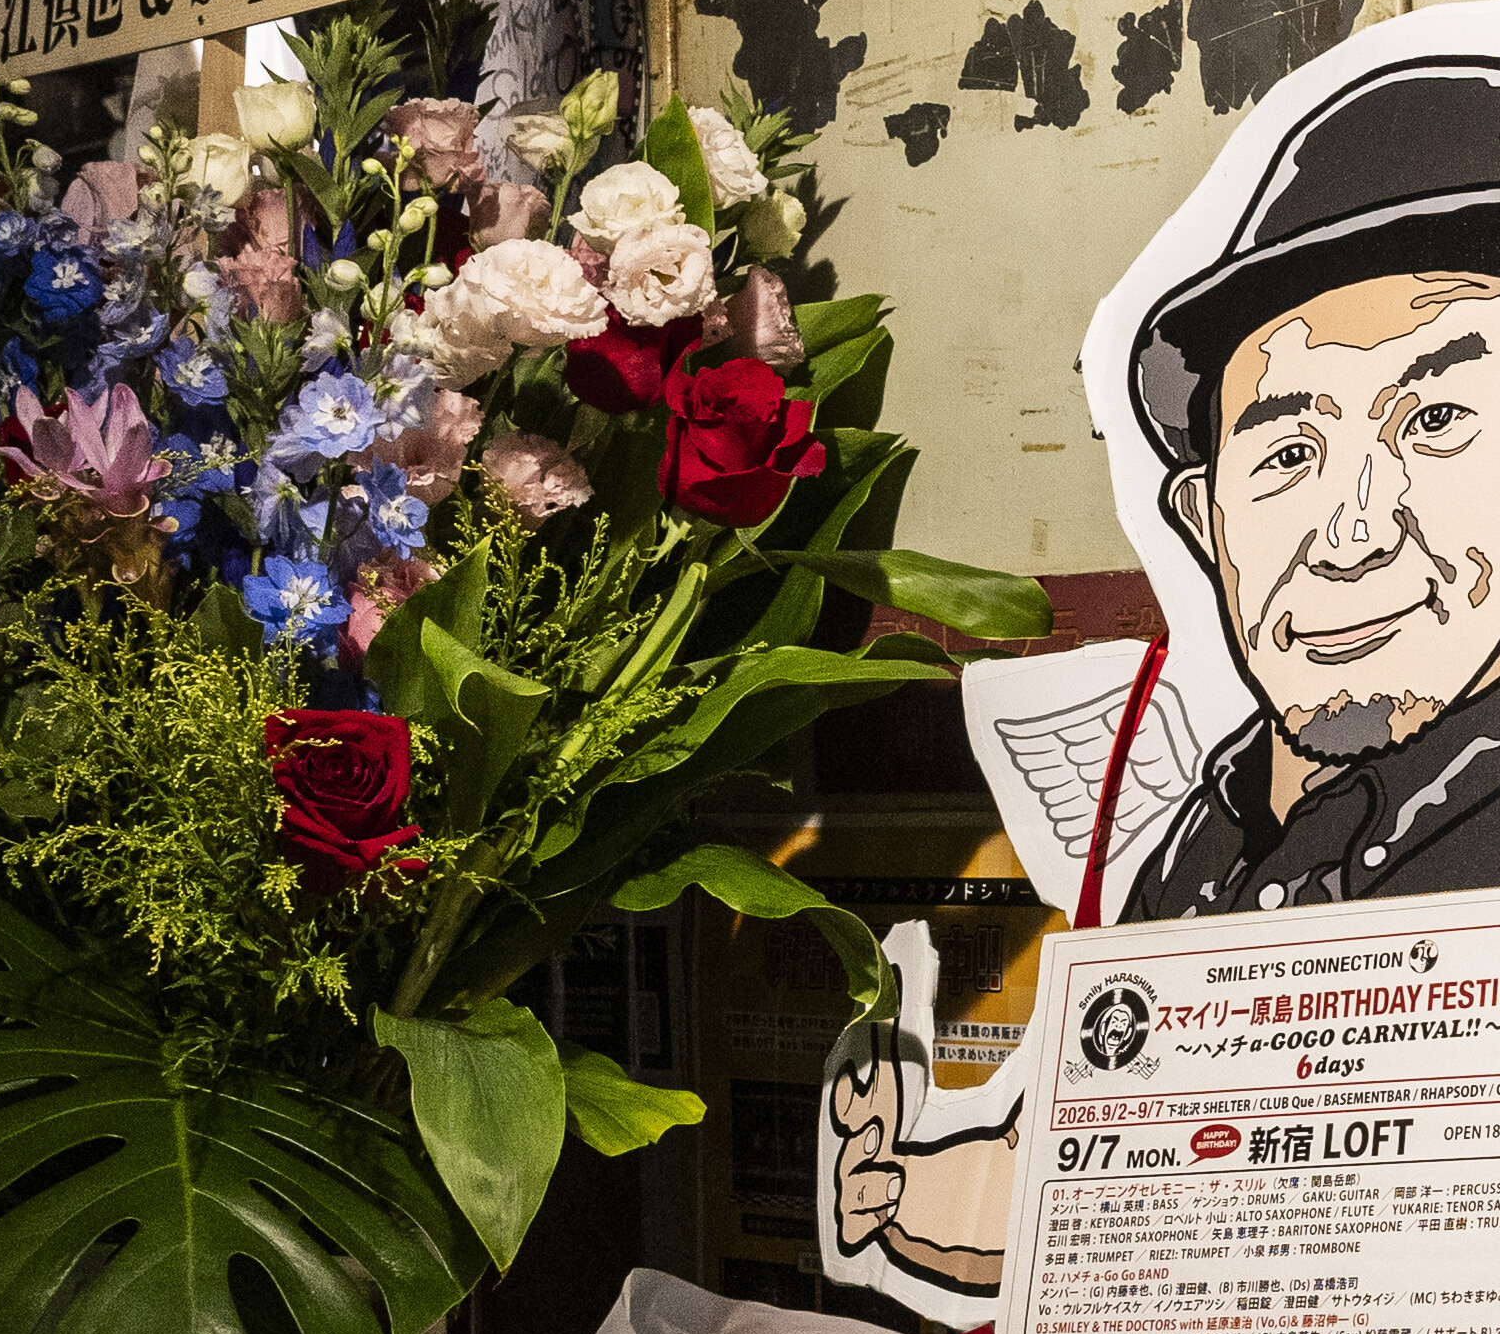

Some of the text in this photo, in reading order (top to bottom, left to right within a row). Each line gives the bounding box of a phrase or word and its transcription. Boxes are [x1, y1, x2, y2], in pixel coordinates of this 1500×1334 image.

[1206, 951, 1404, 984] SMILEY'S CONNECTION
[1104, 972, 1158, 1005] HARASHIMA
[1154, 994, 1293, 1033] スマイリー原島
[1297, 984, 1423, 1022] BIRTHDAY
[1202, 1098, 1251, 1115] SHELTER
[1323, 1089, 1412, 1107] BASEMENTBAR
[1420, 1084, 1487, 1101] RHAPSODY
[1056, 1133, 1121, 1173] 9/7
[1126, 1148, 1181, 1170] MON.
[1248, 1124, 1314, 1164] 新宿
[1323, 1118, 1414, 1160] LOFT
[1443, 1125, 1481, 1141] OPEN
[1202, 1129, 1231, 1141] HAPPY
